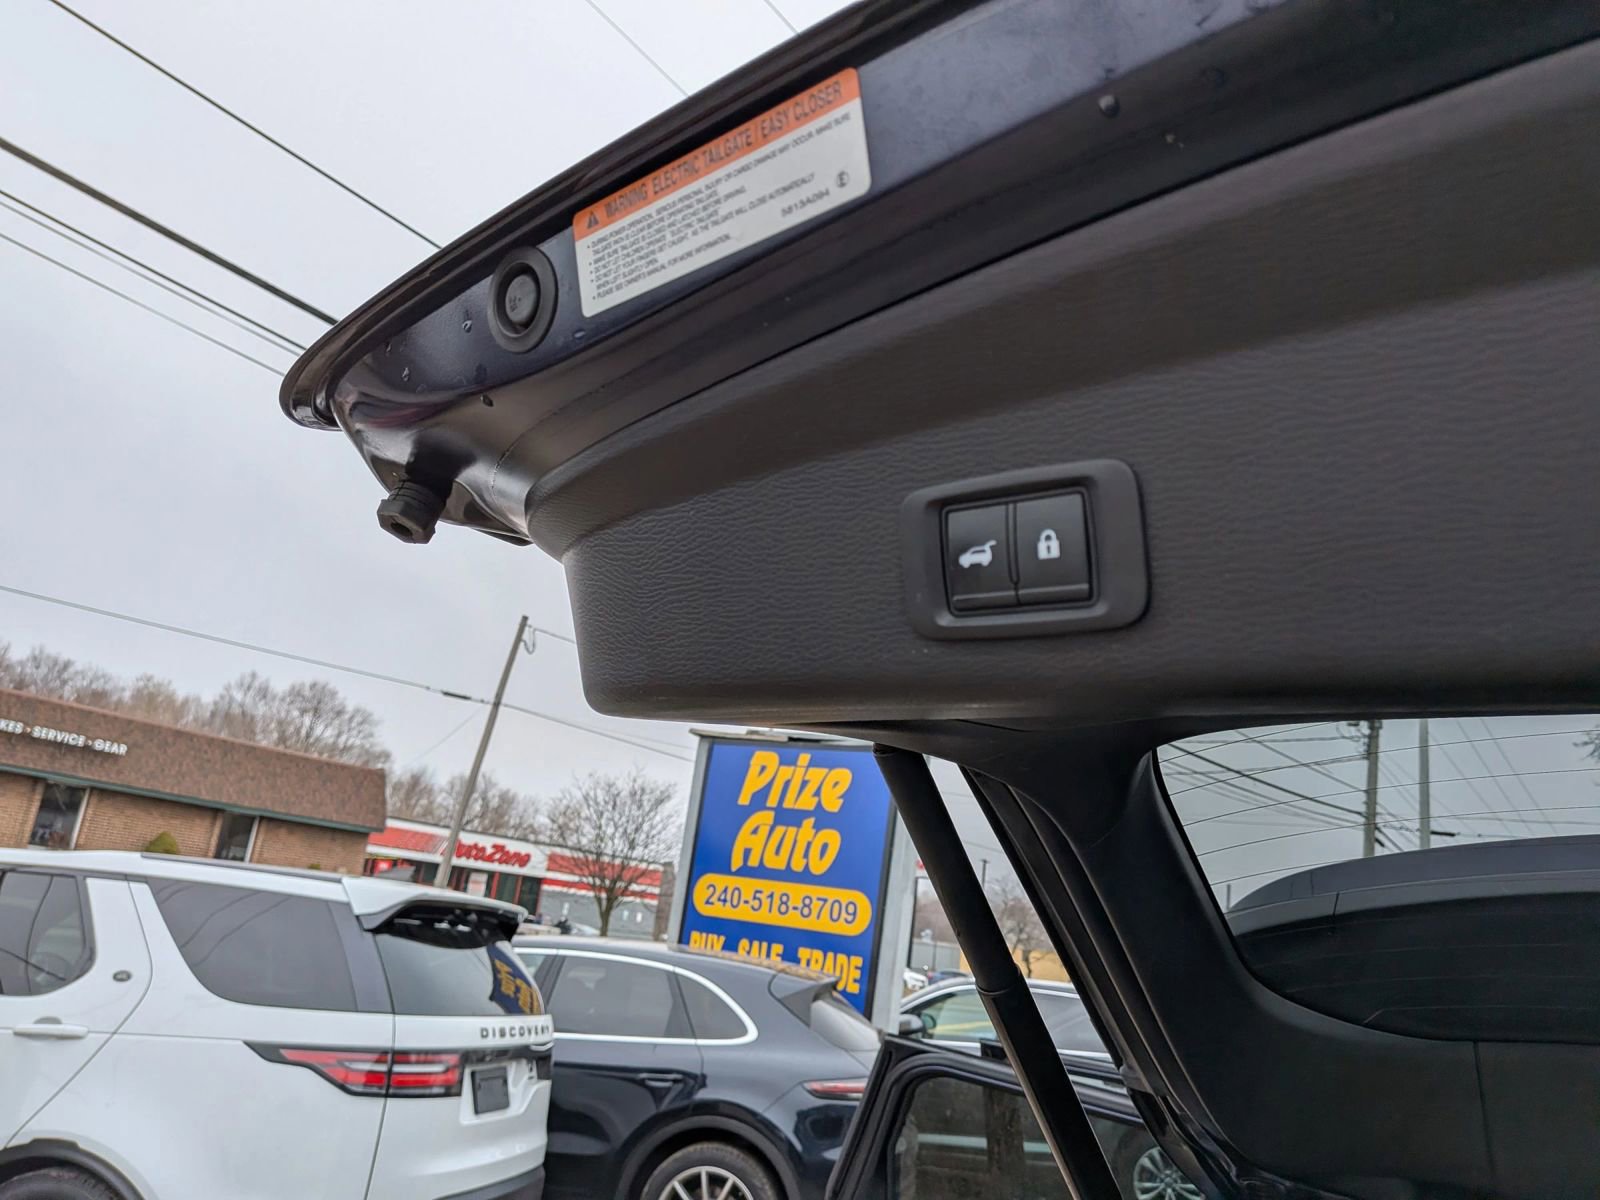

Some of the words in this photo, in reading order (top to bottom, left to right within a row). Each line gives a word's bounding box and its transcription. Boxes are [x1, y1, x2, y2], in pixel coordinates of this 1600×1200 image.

[604, 183, 648, 219] WARNING
[652, 156, 700, 195] ELECTRIC
[702, 128, 752, 169] TAILGATE
[760, 109, 789, 139] EASY
[793, 80, 842, 122] CLOSER
[31, 726, 86, 747] SERVICE
[93, 739, 128, 756] GEAR
[738, 751, 853, 813] Prize
[730, 811, 842, 875] Auto
[704, 884, 857, 924] 240-518-8709
[481, 1025, 550, 1038] DISCOVERY
